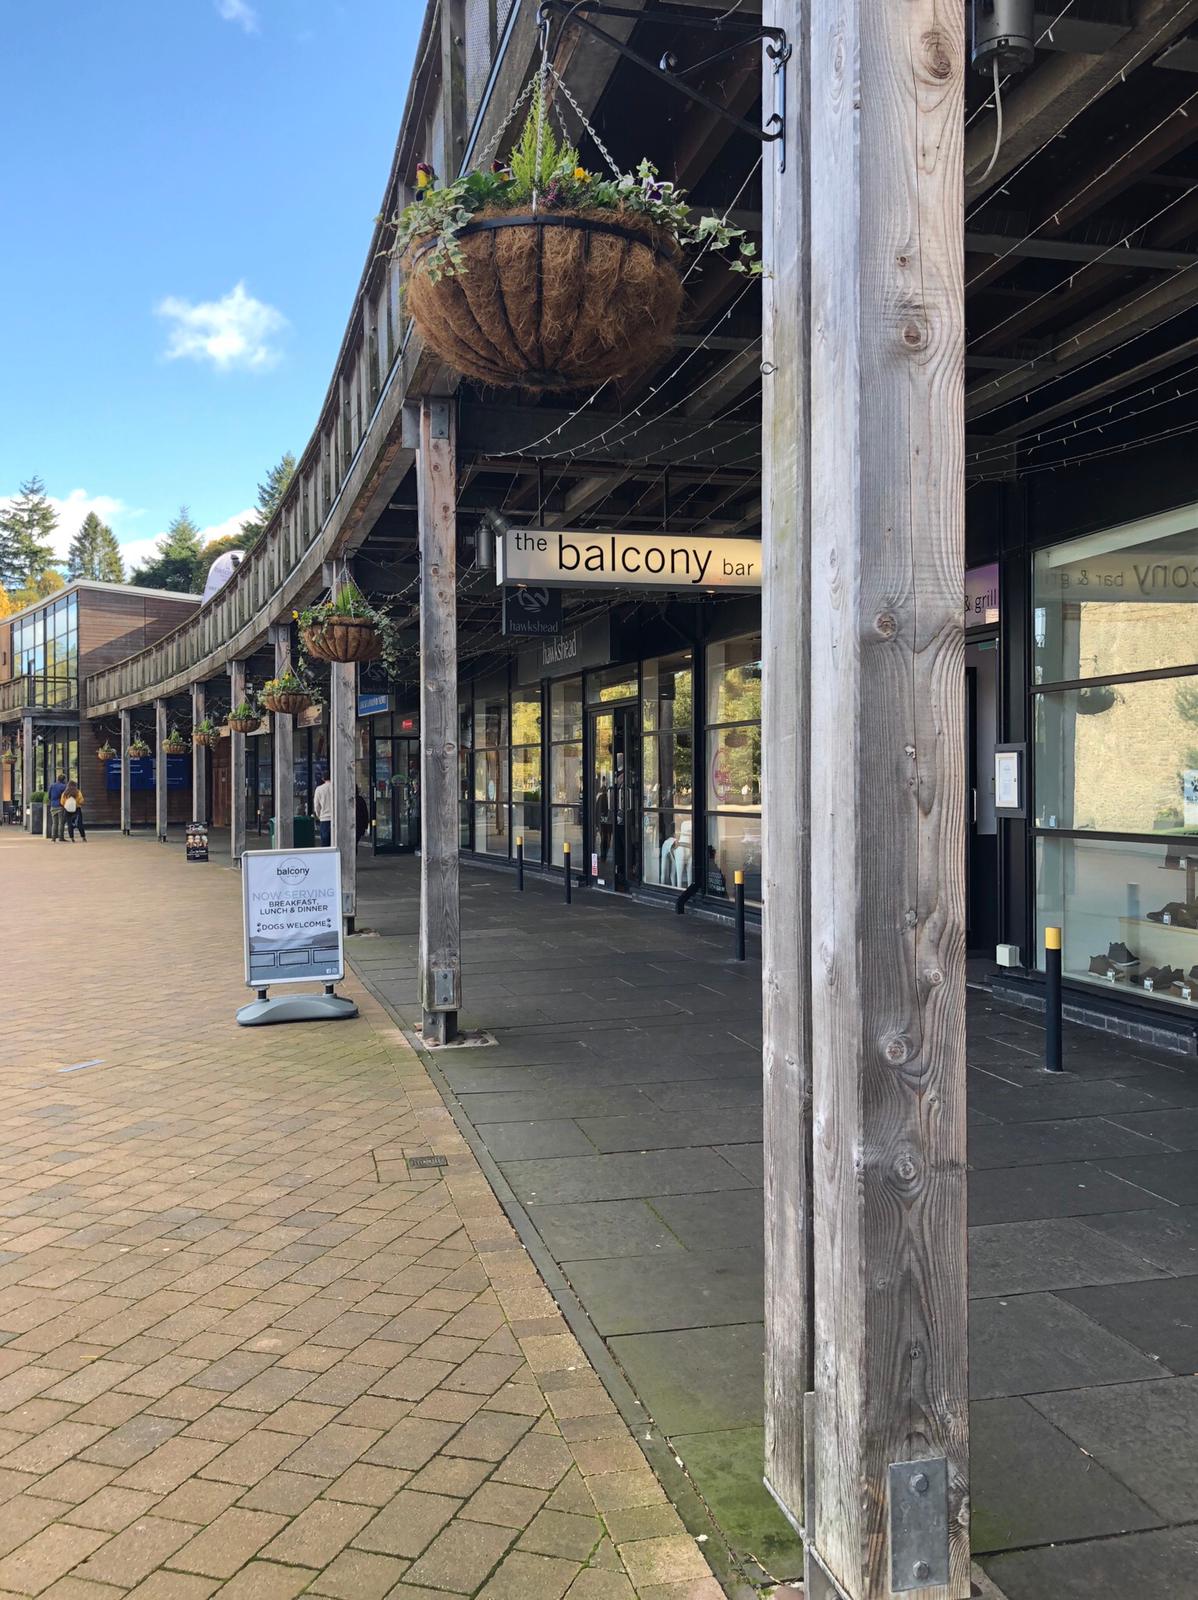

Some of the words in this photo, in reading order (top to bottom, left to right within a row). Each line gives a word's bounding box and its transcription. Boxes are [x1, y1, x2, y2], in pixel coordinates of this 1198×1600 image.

[514, 533, 548, 551] the
[558, 534, 712, 584] balcony
[722, 558, 754, 576] bar
[974, 588, 997, 614] grill
[509, 620, 559, 633] hawkshead
[542, 629, 577, 665] hawkshead
[276, 866, 310, 877] balcony
[252, 890, 282, 901] NOW
[284, 888, 335, 899] SERVING
[260, 907, 288, 915] LUNCH
[298, 905, 328, 913] DINNER
[269, 899, 319, 908] BREAKFAST,
[262, 922, 285, 930] DOGS
[286, 920, 327, 929] WELCOME
